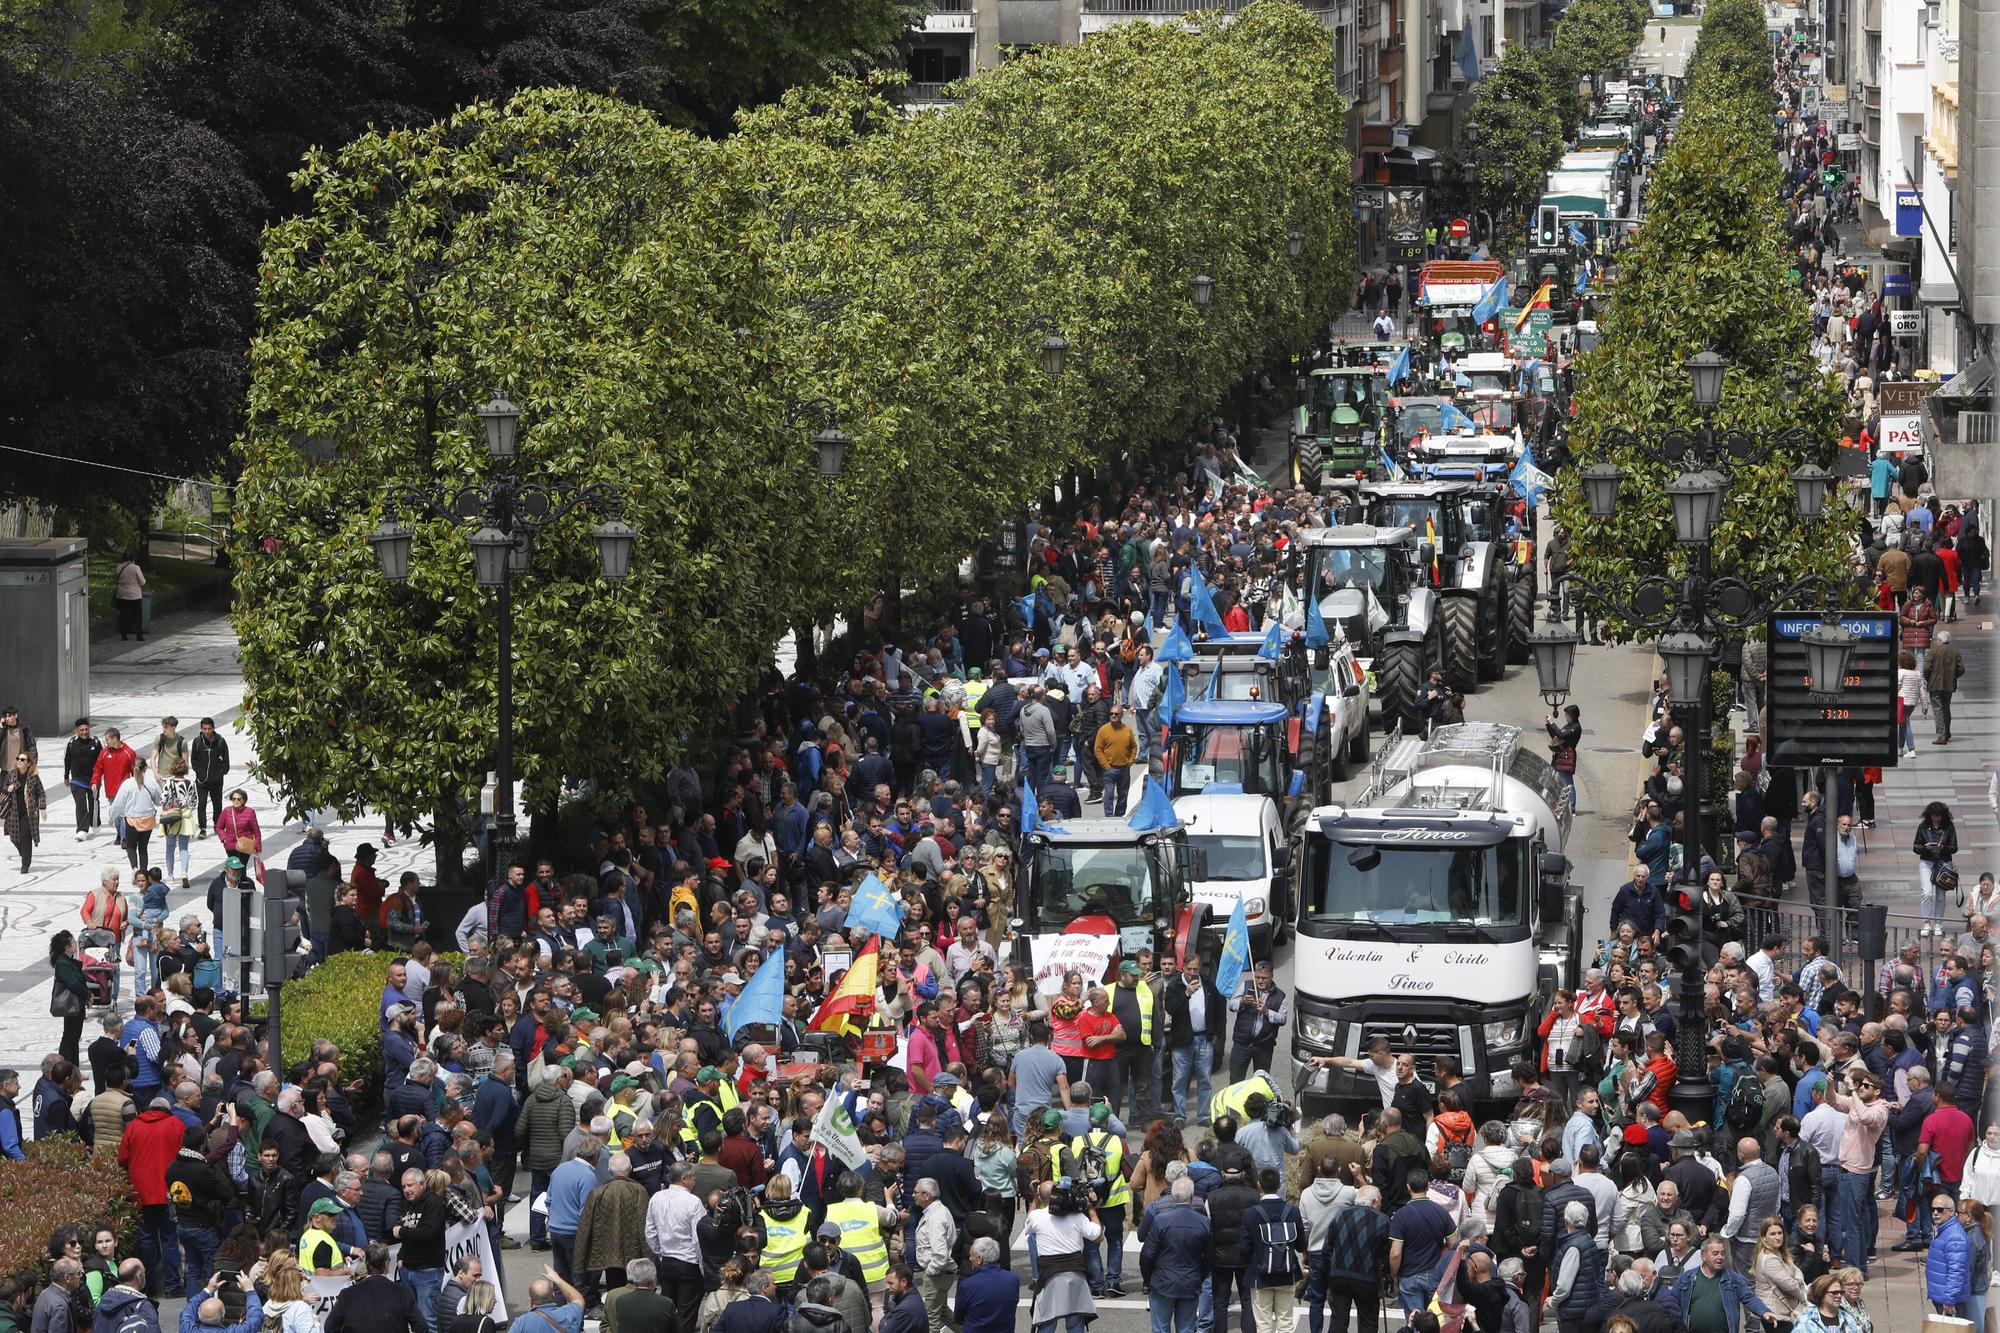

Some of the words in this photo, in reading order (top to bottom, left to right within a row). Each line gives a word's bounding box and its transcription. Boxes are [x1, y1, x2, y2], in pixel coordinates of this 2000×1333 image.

[1896, 321, 1917, 330] ORO
[1382, 827, 1469, 840] Tineo
[1443, 950, 1488, 966] Olvido
[1388, 974, 1434, 991] Tineo
